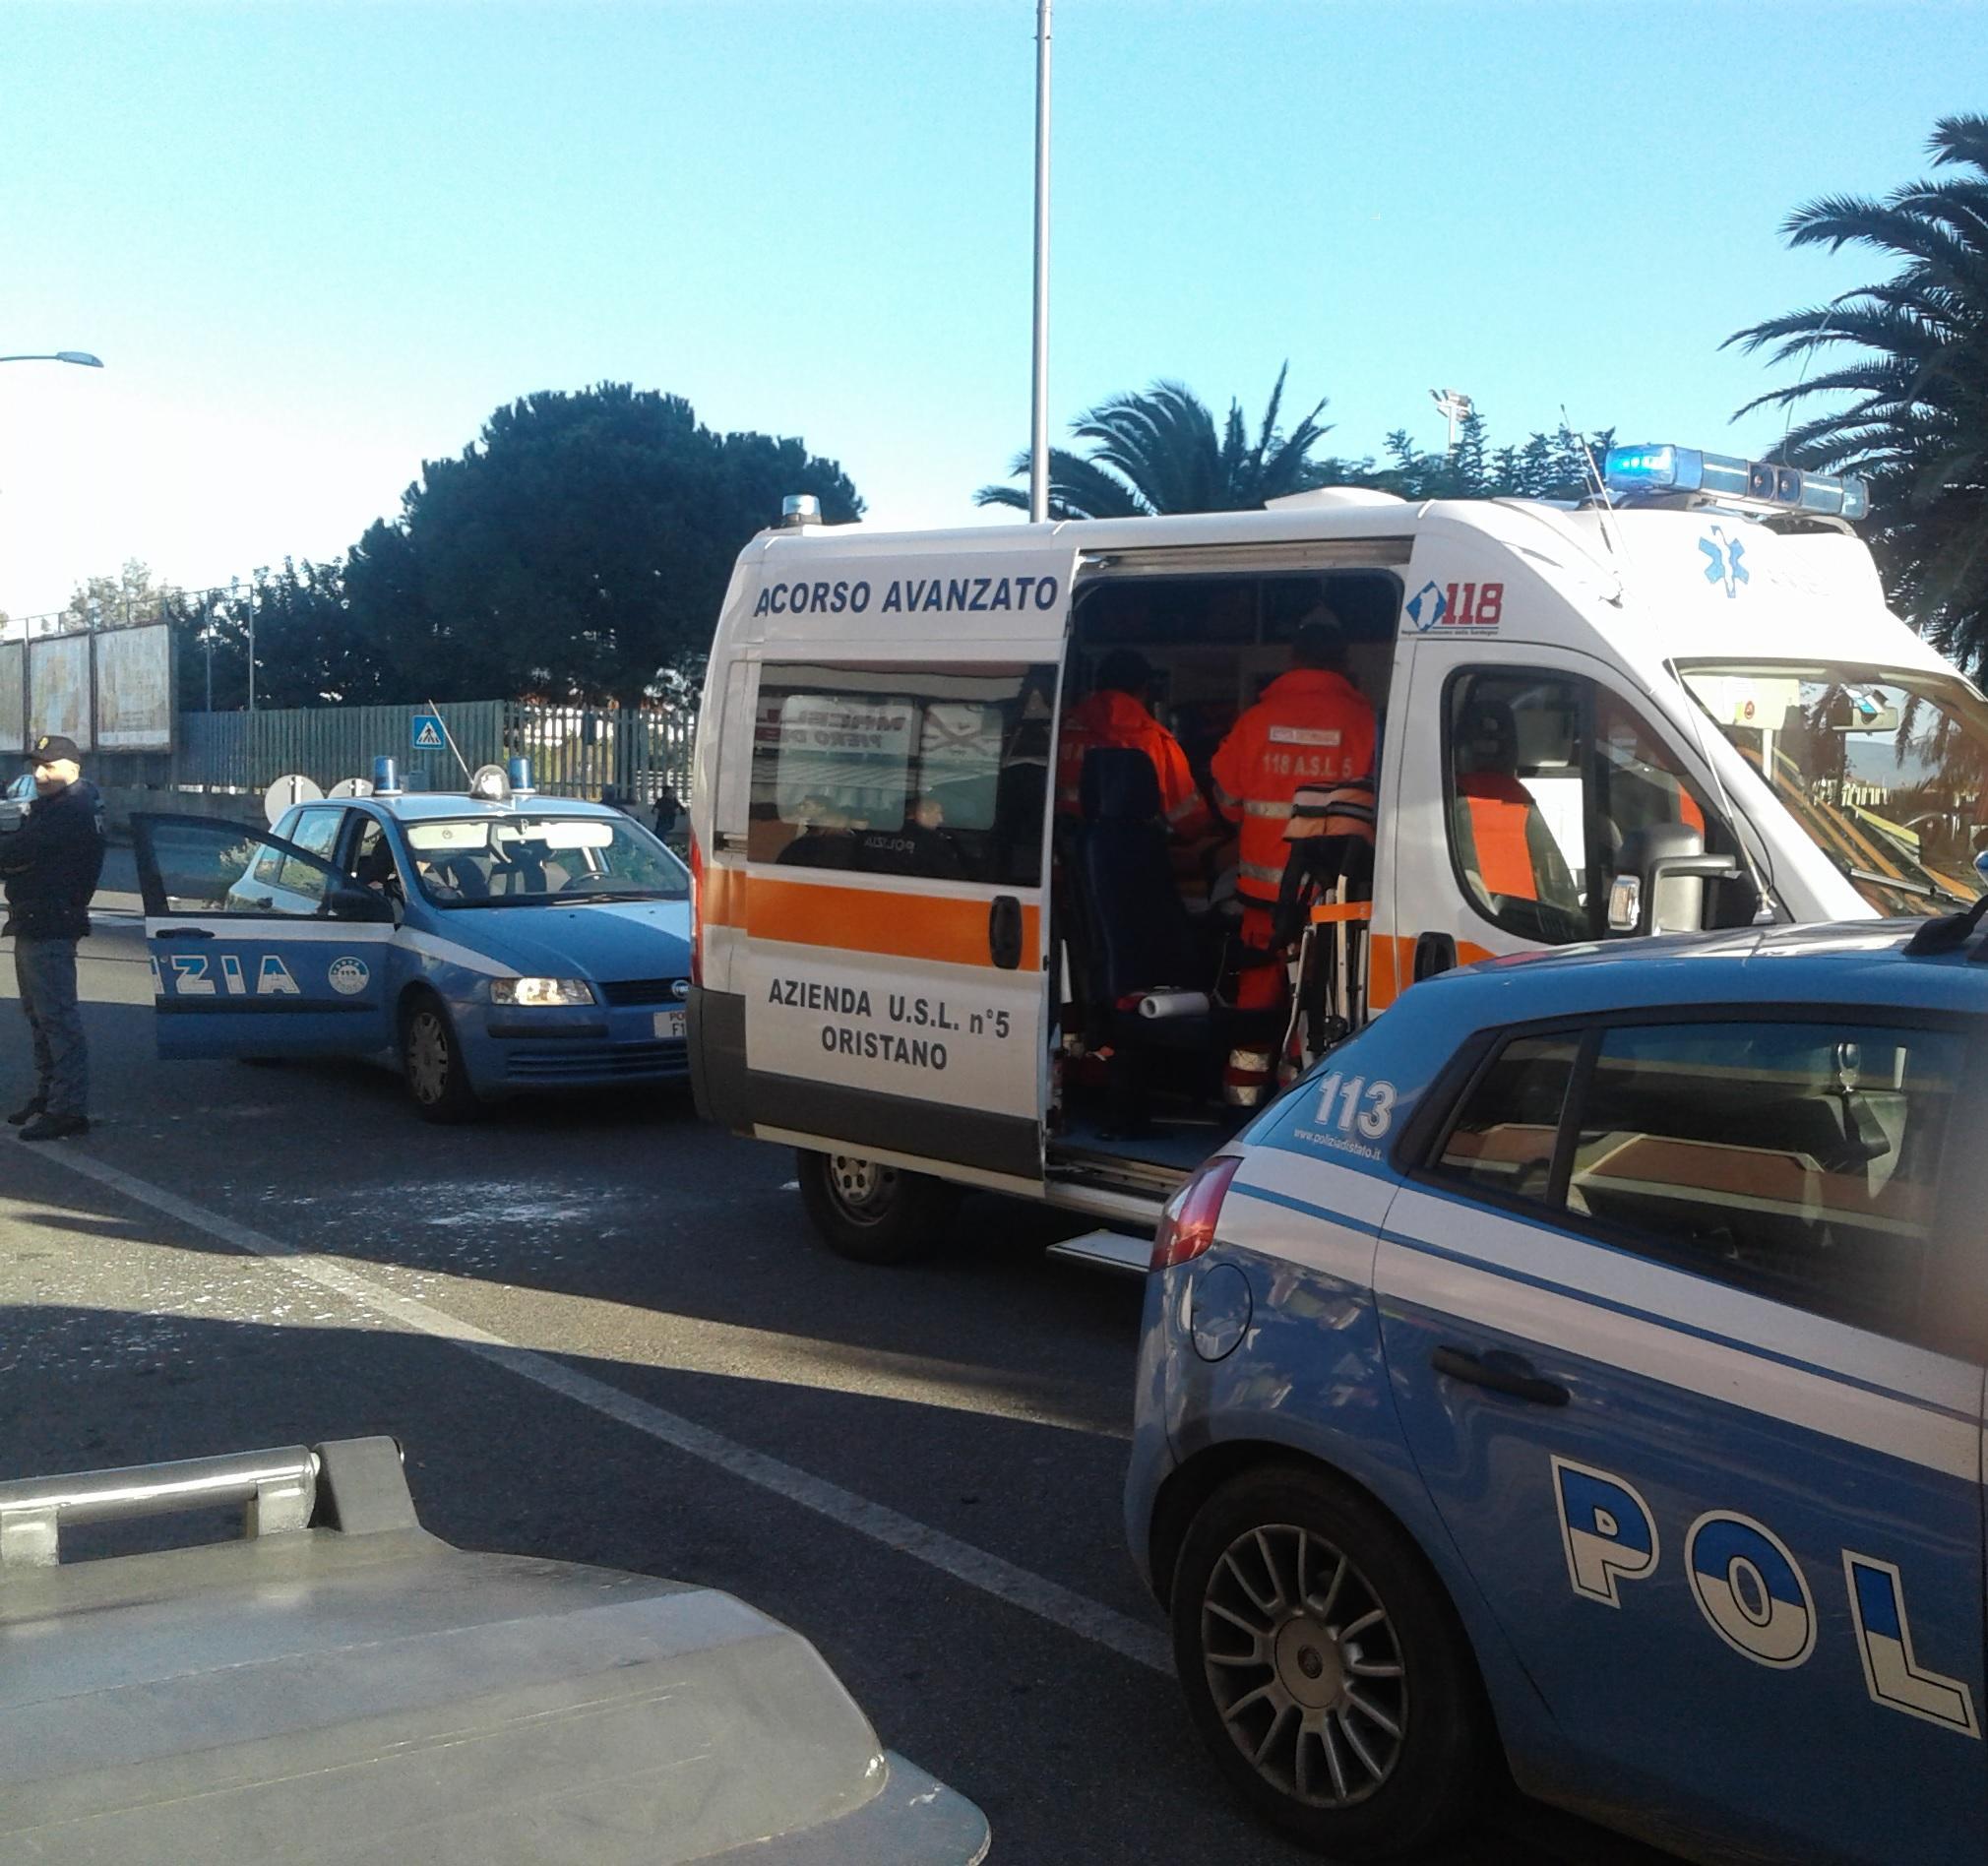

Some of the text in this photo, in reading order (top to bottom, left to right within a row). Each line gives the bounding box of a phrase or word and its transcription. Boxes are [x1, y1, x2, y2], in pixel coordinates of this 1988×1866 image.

[753, 576, 1059, 617] ACORSO AVANZATO
[1442, 583, 1505, 624] 118
[1264, 752, 1290, 776] 118
[1341, 757, 1352, 778] 5
[769, 978, 872, 1017] AZIENDA
[889, 994, 961, 1030] U.S.L.
[821, 1026, 948, 1070] ORISTANO
[1315, 1071, 1398, 1139] 113
[1550, 1455, 1982, 1740] POL
